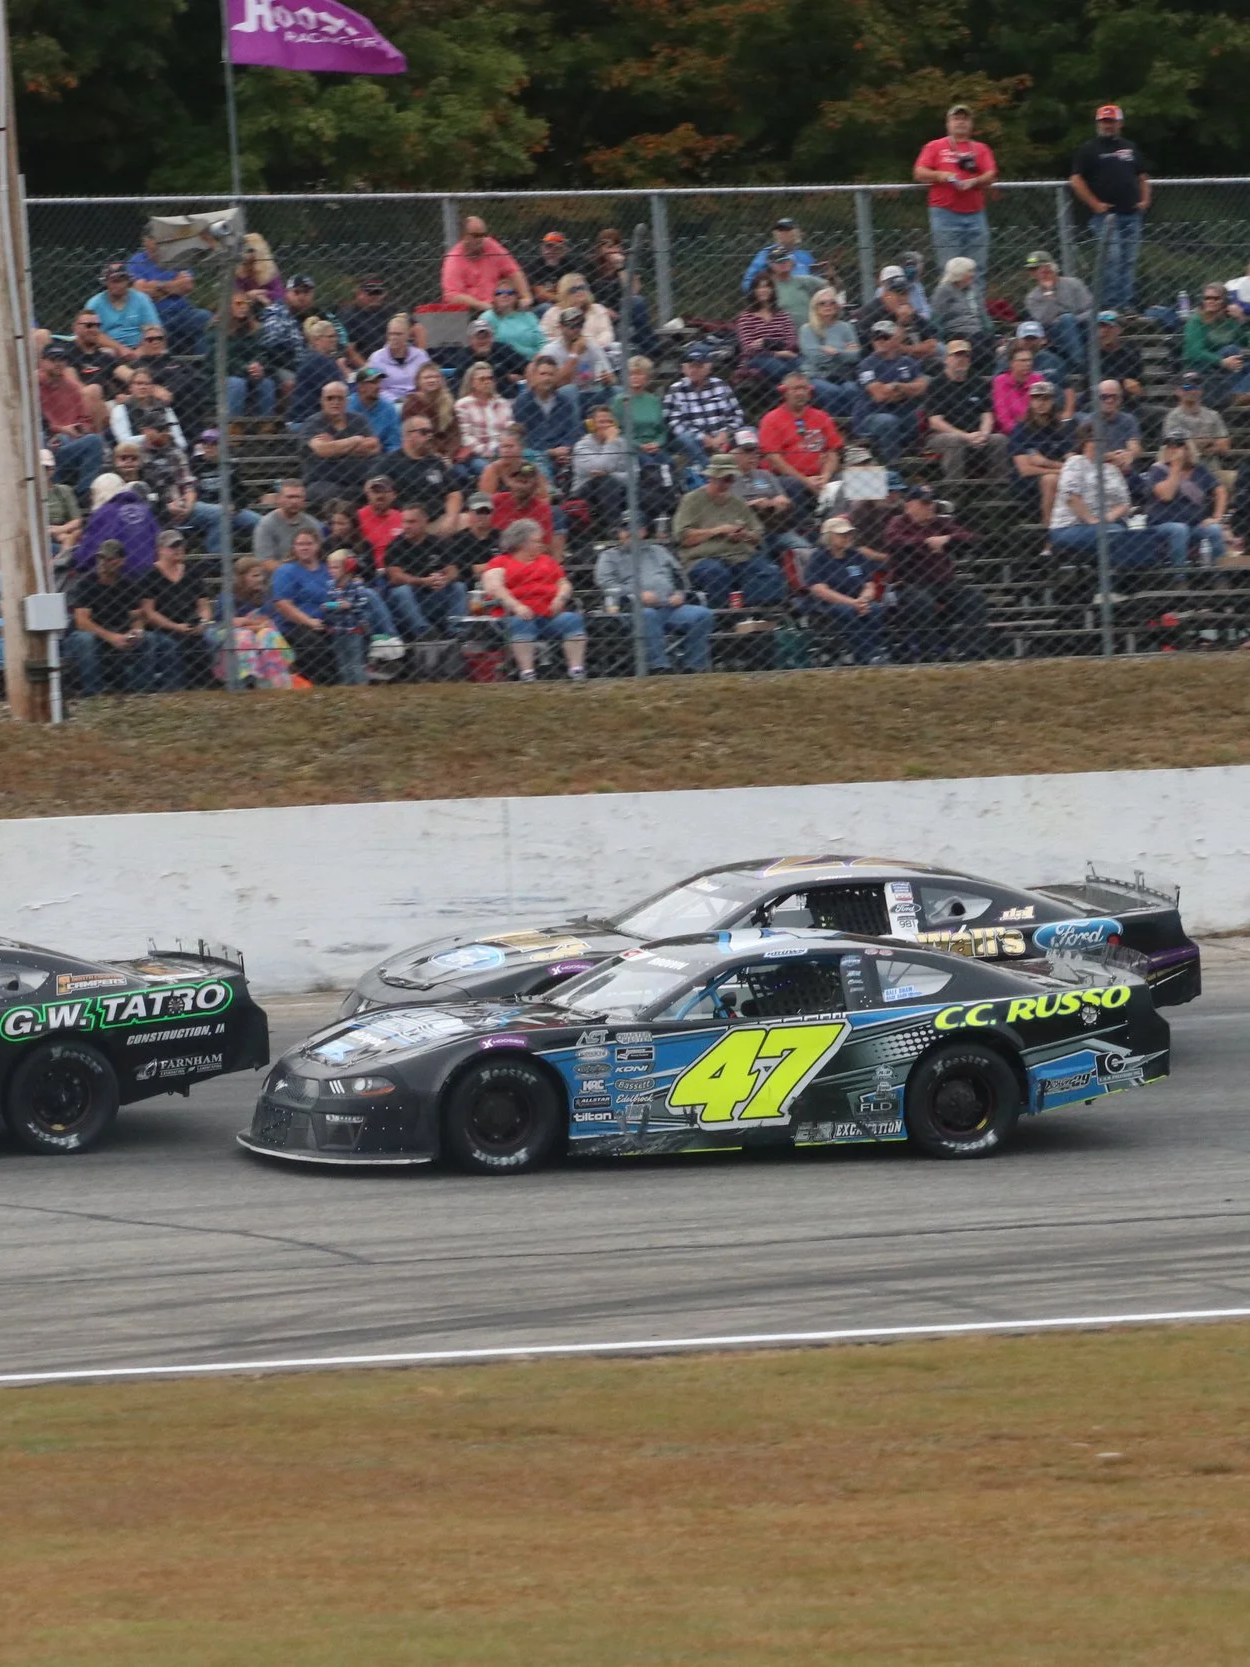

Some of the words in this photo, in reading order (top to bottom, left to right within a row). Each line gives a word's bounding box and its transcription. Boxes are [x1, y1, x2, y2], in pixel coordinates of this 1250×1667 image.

[895, 904, 915, 913] Ford
[1052, 922, 1105, 947] Ford
[4, 1003, 87, 1036] G.W.
[102, 983, 226, 1022] TATRO
[934, 1003, 997, 1030] C.C.
[1006, 985, 1131, 1023] RUSSO
[126, 1024, 212, 1046] CONSTRUCTION,
[576, 1030, 609, 1047] ACT
[160, 1053, 223, 1069] FARNHAM
[615, 1065, 648, 1073] KONI
[667, 1022, 847, 1124] 47
[618, 1081, 651, 1091] Bassett
[616, 1094, 654, 1104] Edelbrock
[860, 1102, 892, 1112] FLD
[573, 1113, 612, 1122] tilton
